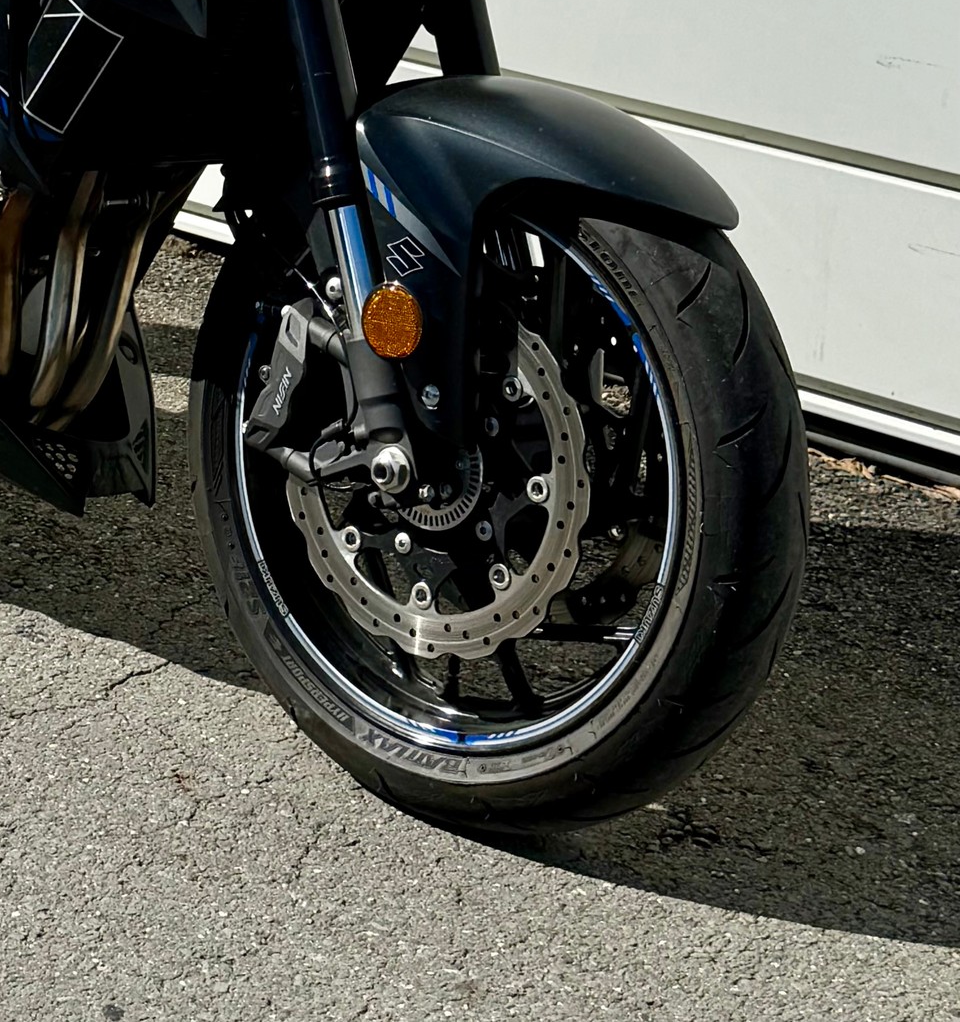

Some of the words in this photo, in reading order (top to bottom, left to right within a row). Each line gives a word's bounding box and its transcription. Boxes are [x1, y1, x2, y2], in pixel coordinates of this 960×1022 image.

[272, 365, 292, 416] NISSIN
[257, 559, 289, 617] SUZUKI
[634, 584, 664, 644] SUZUKI
[281, 654, 351, 723] HYPERSPORT
